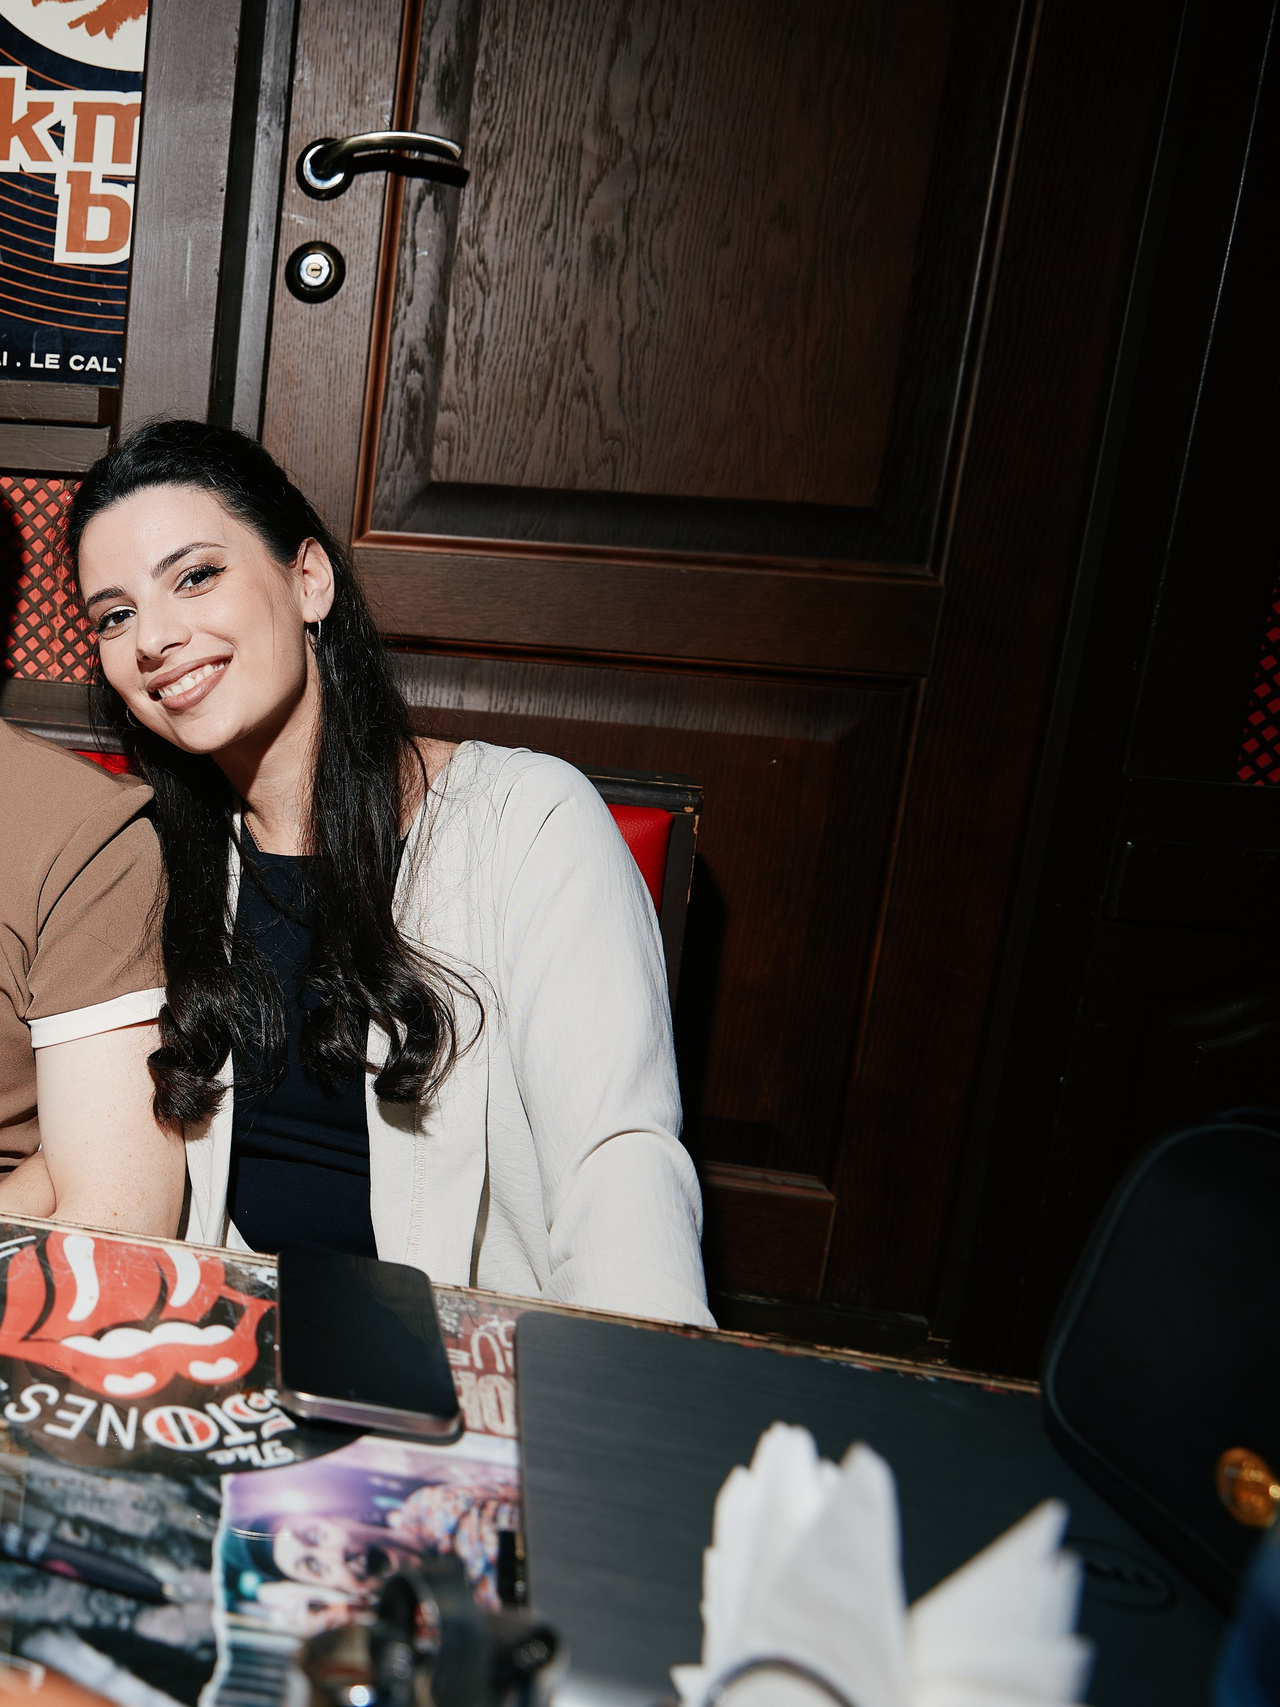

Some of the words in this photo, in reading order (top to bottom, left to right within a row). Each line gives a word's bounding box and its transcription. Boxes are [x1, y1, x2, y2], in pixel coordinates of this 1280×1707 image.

[30, 352, 61, 370] LE
[3, 1383, 297, 1452] STONES
[206, 1439, 295, 1469] The
